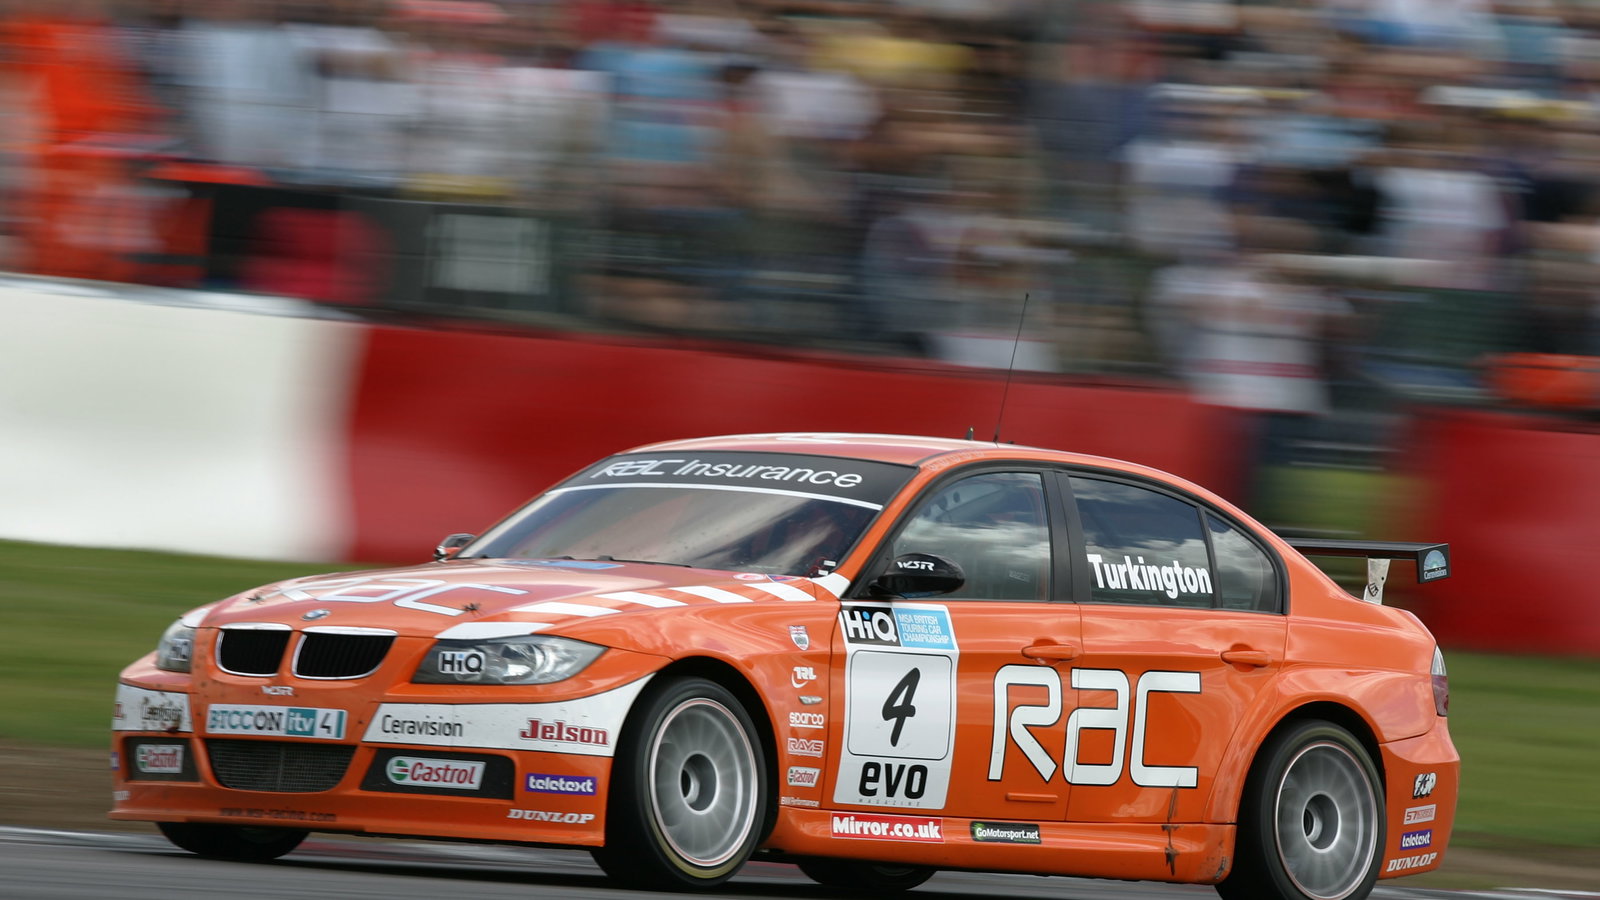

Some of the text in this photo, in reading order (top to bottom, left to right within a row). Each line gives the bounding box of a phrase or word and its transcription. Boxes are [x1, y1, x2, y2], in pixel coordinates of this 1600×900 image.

[675, 459, 863, 488] Insurance
[897, 560, 935, 571] WSR
[1087, 554, 1213, 599] Turkington
[843, 610, 898, 643] HiQ
[898, 613, 938, 625] MSA BRITISH
[901, 622, 942, 635] TOURING CAR
[903, 632, 949, 644] CHAMPIONSHIP
[441, 651, 484, 675] HiQ
[882, 667, 921, 747] 4
[320, 712, 332, 735] 4
[381, 714, 463, 737] Ceravision
[789, 711, 824, 725] sparco
[987, 664, 1202, 788] RAC
[520, 718, 609, 746] Jelson
[788, 737, 824, 753] RAYS
[410, 762, 477, 785] Castrol
[529, 775, 594, 793] teletext
[793, 769, 817, 784] Castrol
[858, 762, 928, 799] evo
[507, 808, 595, 824] DUNLOP
[833, 816, 942, 840] Mirror.co.uk
[976, 827, 1039, 840] GoMotorsport.net
[1402, 831, 1431, 848] teletext
[1386, 852, 1437, 872] DUNLOP
